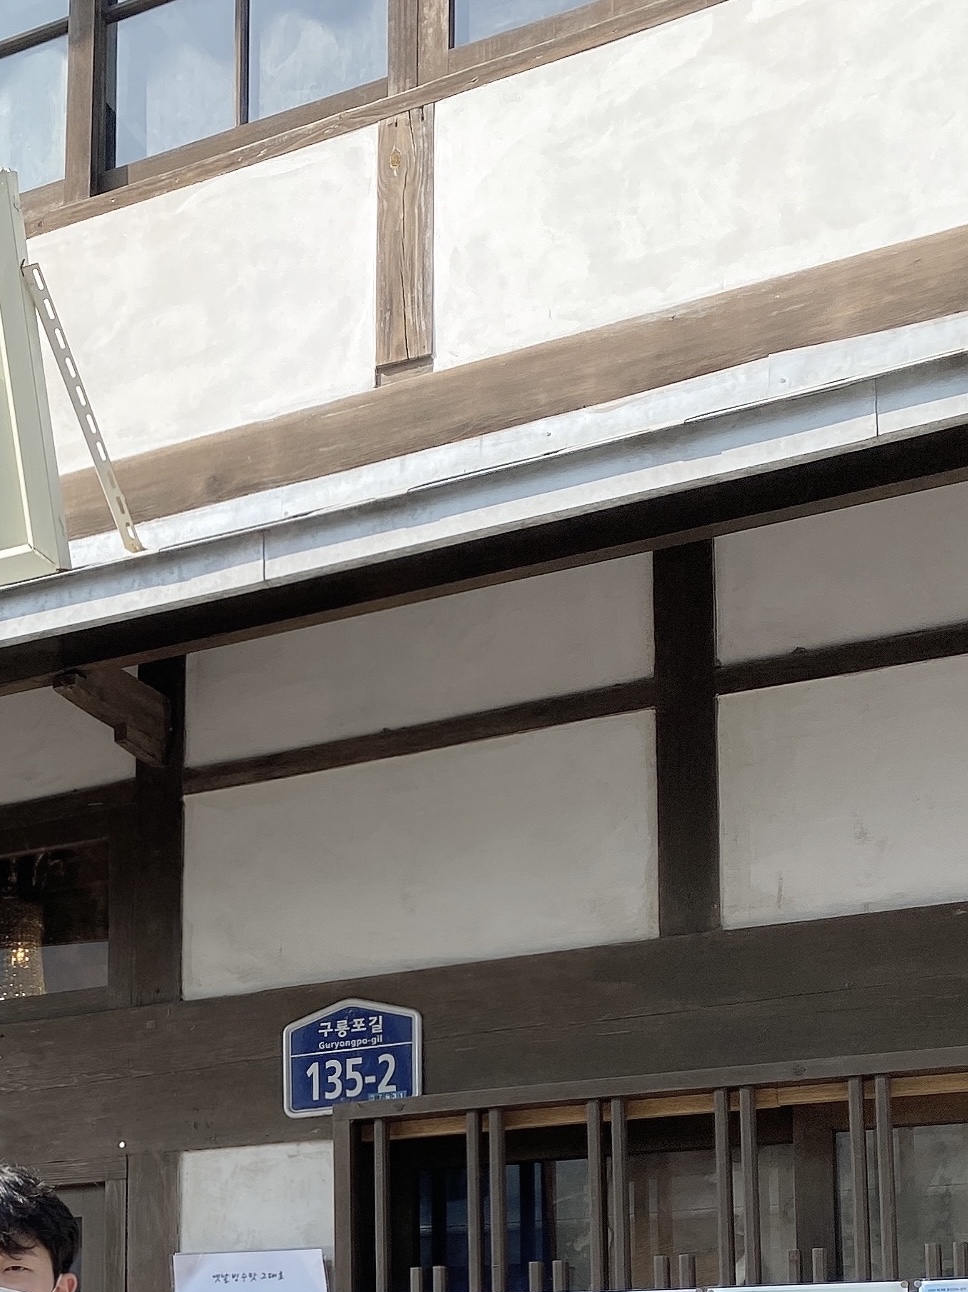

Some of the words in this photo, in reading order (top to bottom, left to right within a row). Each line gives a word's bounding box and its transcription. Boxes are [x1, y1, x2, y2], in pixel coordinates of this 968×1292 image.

[317, 1015, 383, 1038] 구룡포길
[318, 1035, 383, 1050] Guryongpo-gil
[306, 1053, 397, 1101] 135-2
